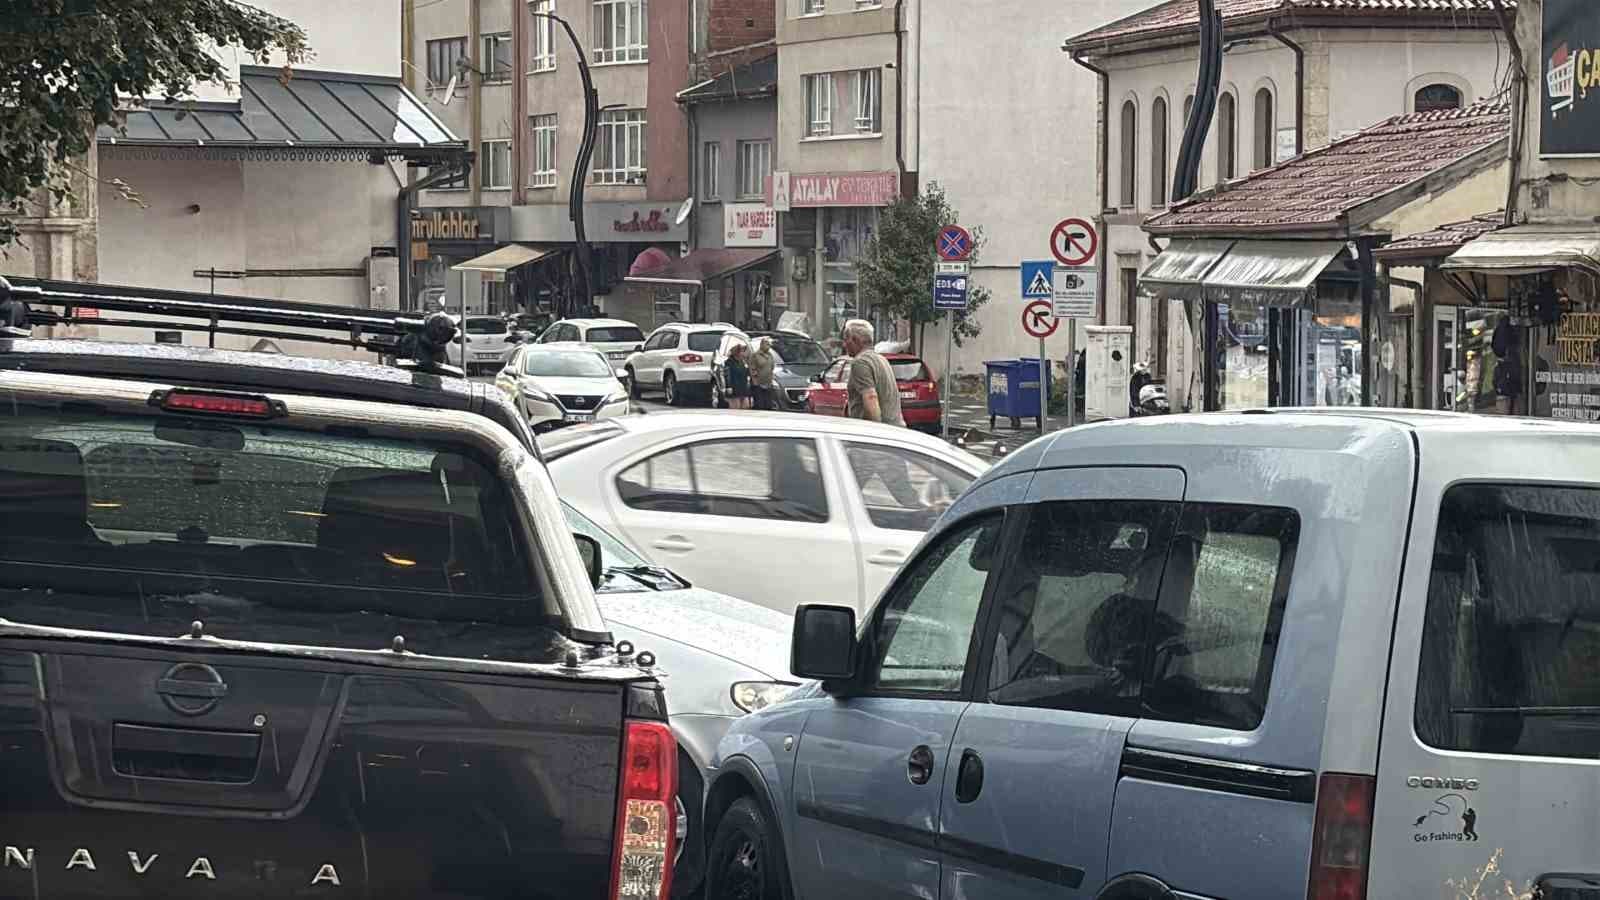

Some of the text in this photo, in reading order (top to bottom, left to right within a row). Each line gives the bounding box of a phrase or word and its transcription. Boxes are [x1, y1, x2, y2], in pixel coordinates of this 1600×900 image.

[793, 176, 840, 202] ATALAY
[1414, 831, 1463, 843] Go Fishing
[5, 845, 341, 886] NAVAA
